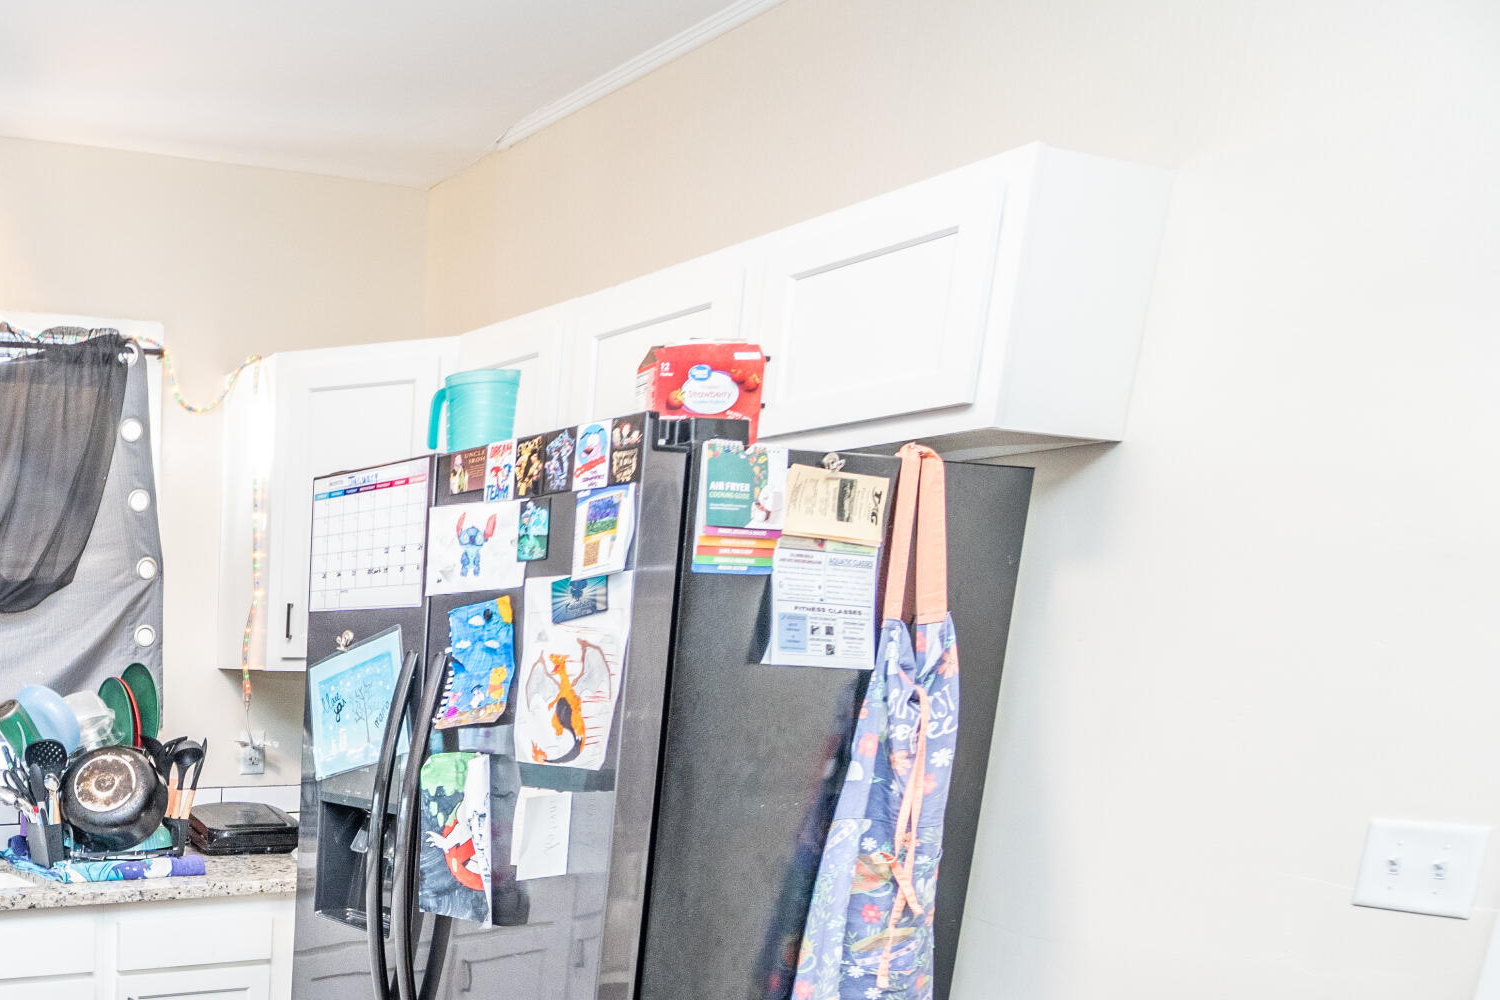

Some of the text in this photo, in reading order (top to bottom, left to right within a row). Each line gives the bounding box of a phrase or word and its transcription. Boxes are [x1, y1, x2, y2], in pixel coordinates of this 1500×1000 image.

[709, 481, 751, 492] AIR FRYER
[486, 484, 510, 501] TEAM
[794, 605, 862, 616] FITNESS CLASSES
